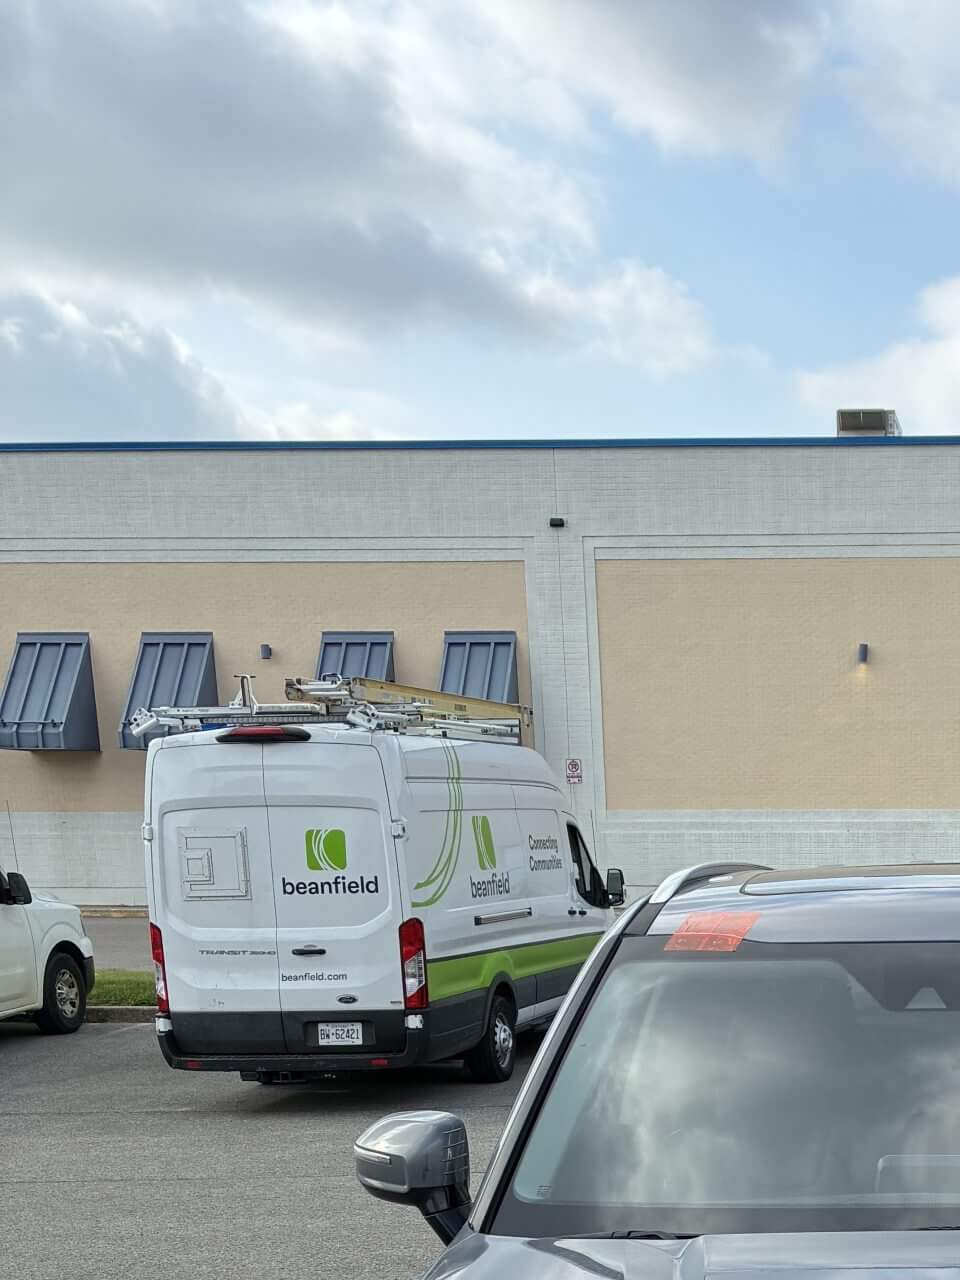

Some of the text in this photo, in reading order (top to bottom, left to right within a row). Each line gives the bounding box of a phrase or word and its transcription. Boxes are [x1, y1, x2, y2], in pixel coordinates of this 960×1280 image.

[528, 834, 559, 853] Connecting
[529, 855, 563, 872] Communities
[281, 875, 380, 895] beanfield
[469, 872, 511, 899] beanfield
[281, 971, 348, 983] beanfield.com
